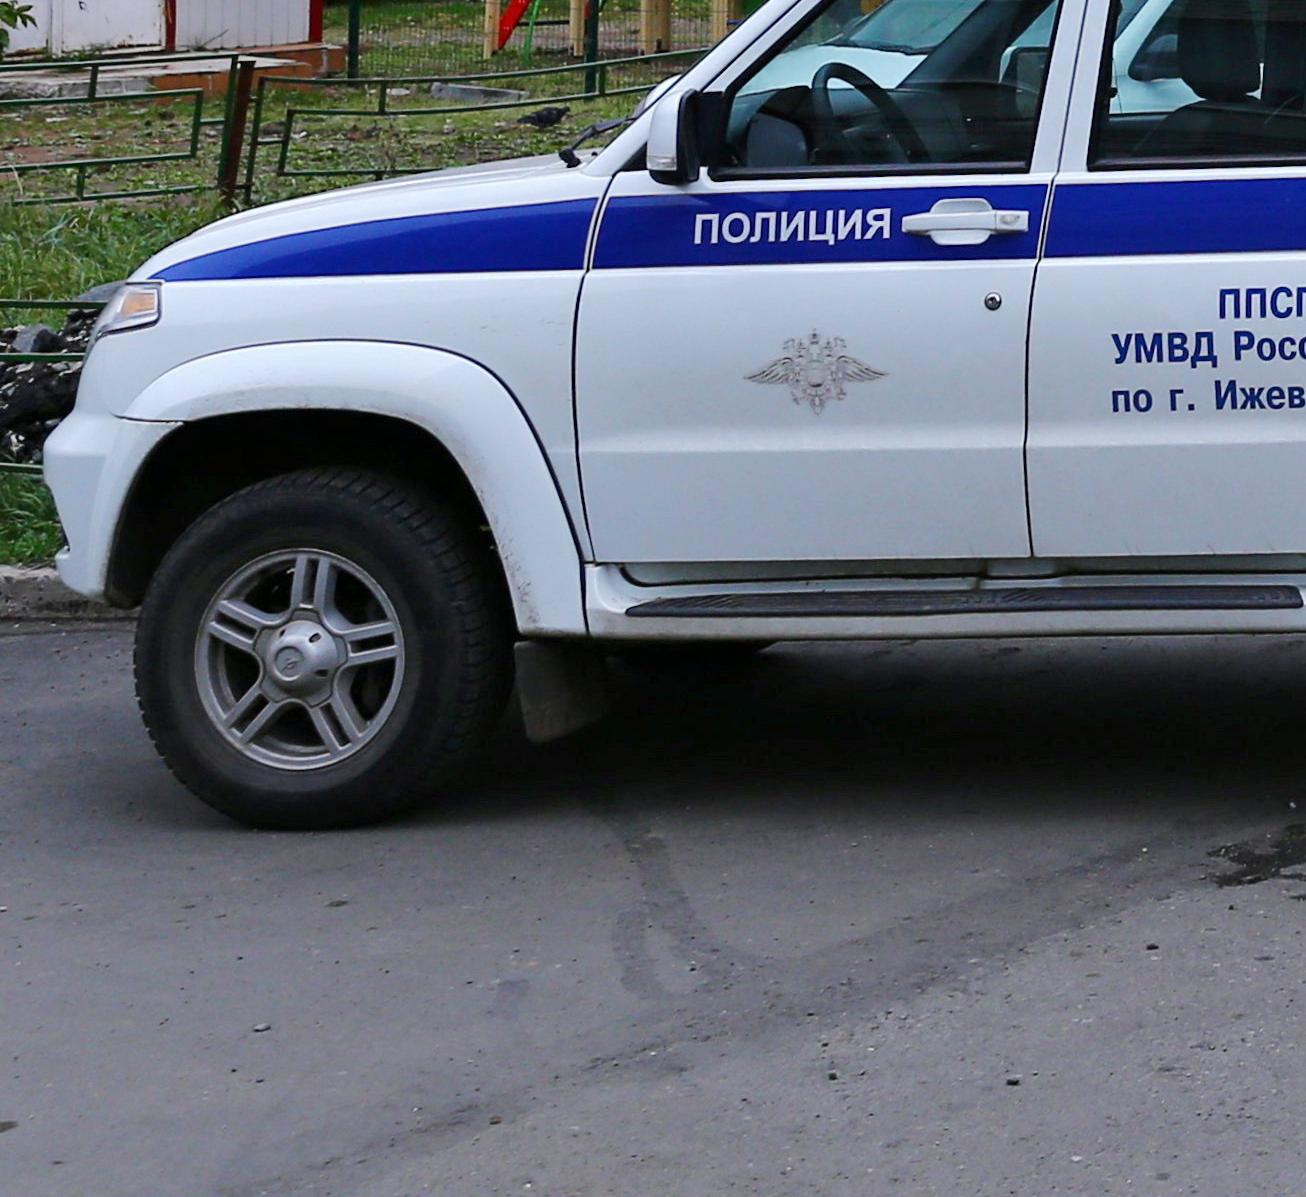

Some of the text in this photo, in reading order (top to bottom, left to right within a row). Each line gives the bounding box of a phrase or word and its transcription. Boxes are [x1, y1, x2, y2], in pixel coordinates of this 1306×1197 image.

[693, 207, 892, 246] ПОЛИЦИЯ
[1110, 331, 1218, 369] УМВД
[1111, 388, 1154, 413] по
[1169, 388, 1196, 412] г.
